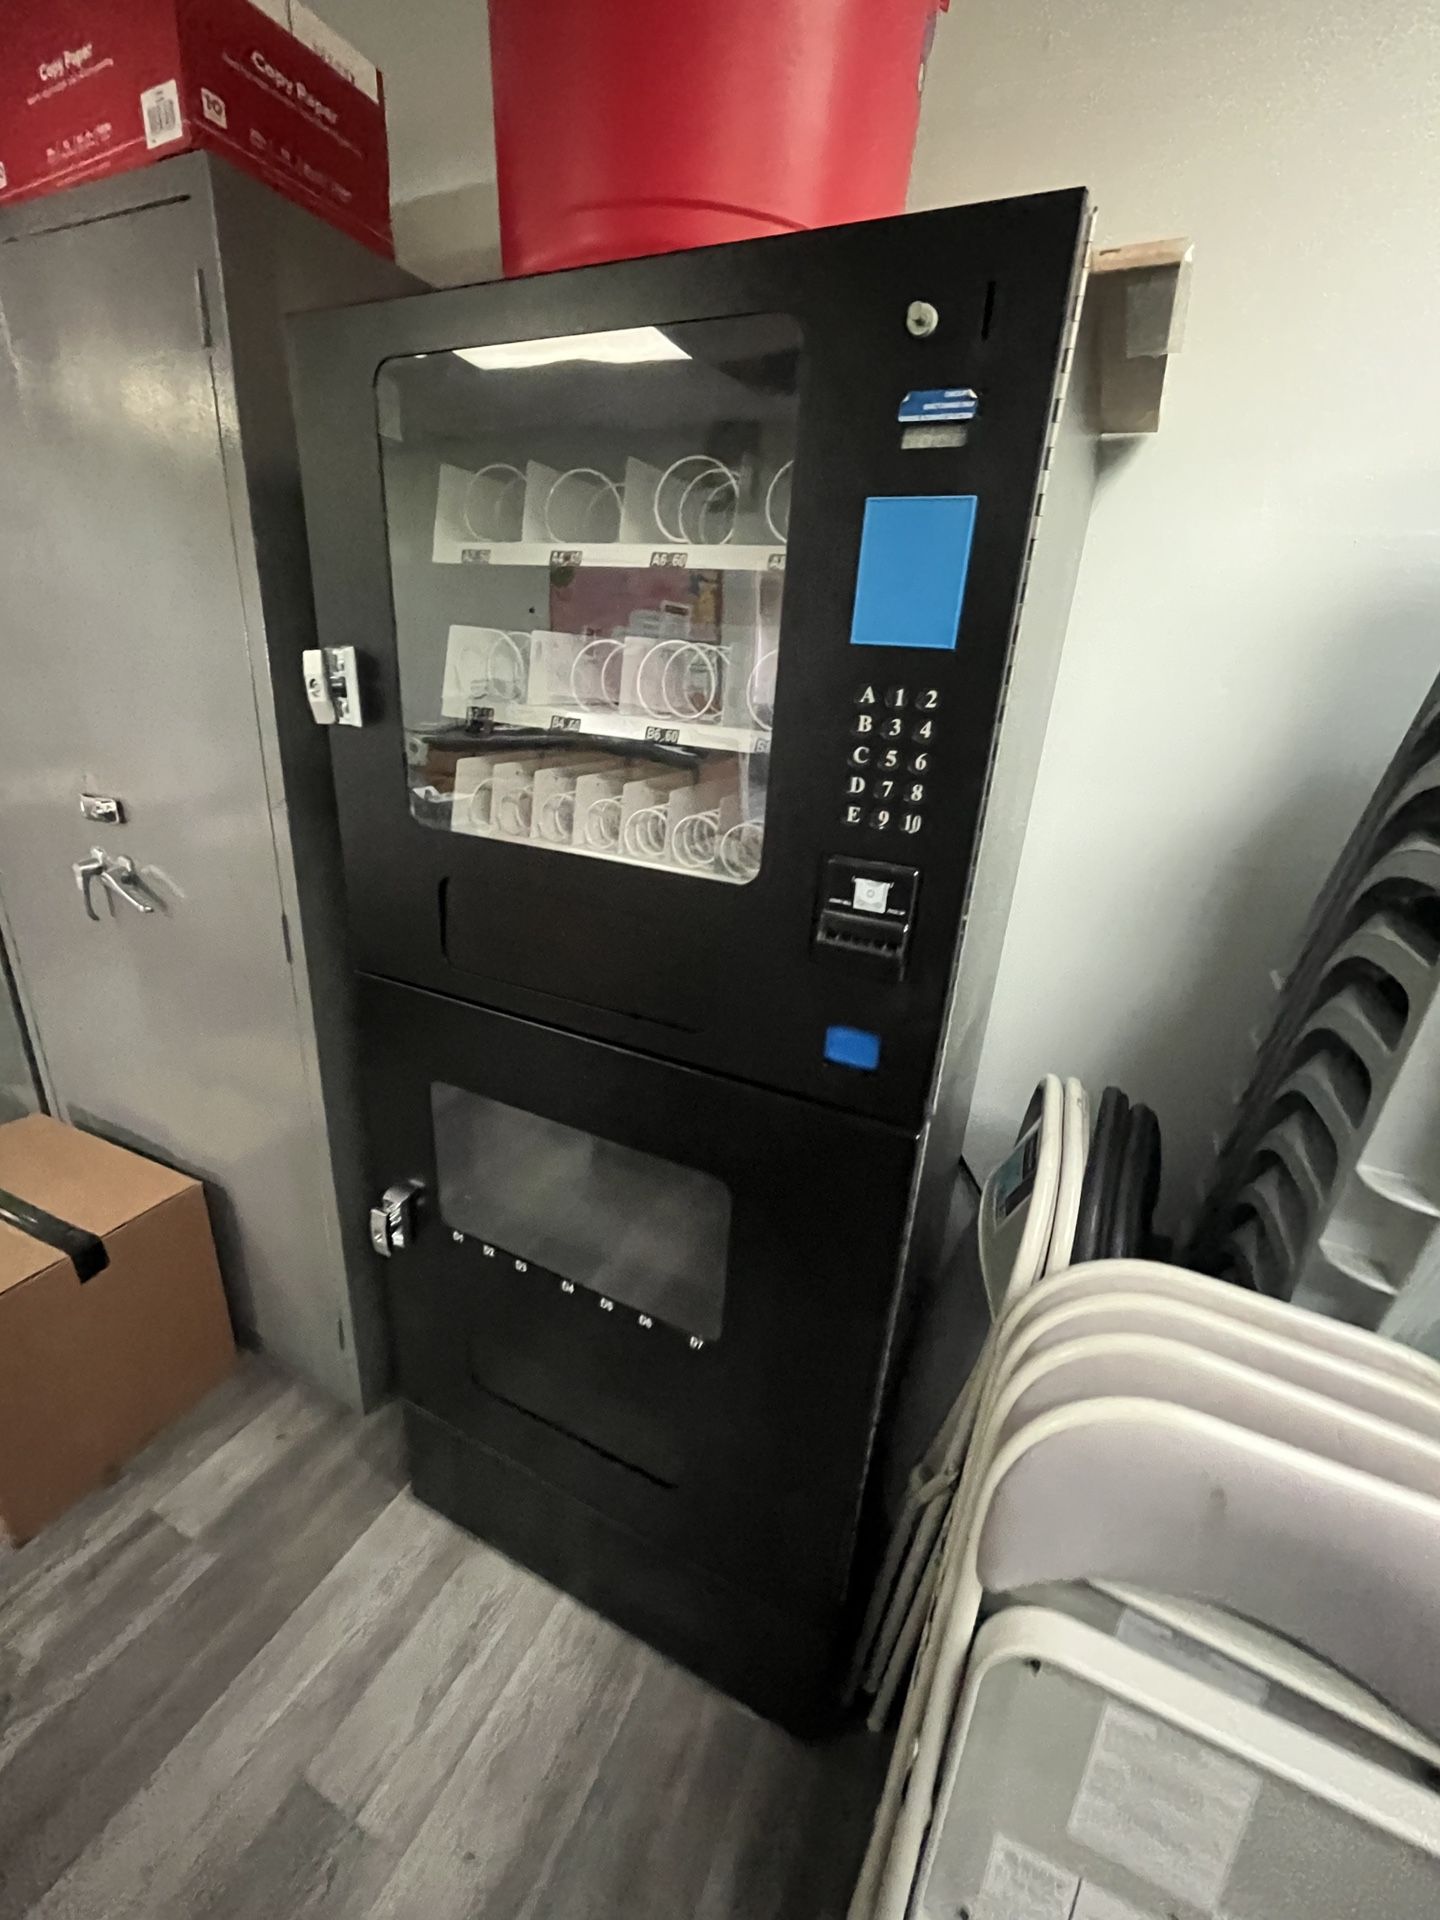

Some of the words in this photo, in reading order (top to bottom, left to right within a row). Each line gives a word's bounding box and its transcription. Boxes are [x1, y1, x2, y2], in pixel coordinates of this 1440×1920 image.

[38, 59, 64, 81] Copy
[63, 43, 92, 70] Paper
[251, 51, 293, 95] Copy
[296, 82, 338, 124] Paper
[860, 686, 875, 704] A
[895, 688, 905, 706] 1
[925, 690, 938, 708] 2
[857, 715, 873, 732] B
[889, 718, 901, 736] 3
[919, 720, 932, 738] 4
[853, 746, 870, 764] C
[885, 750, 898, 767] 5
[915, 752, 928, 770] 6
[850, 776, 866, 793] D
[882, 781, 894, 797] 7
[910, 784, 924, 801] 8
[847, 806, 861, 823] E
[878, 810, 890, 830] 9
[904, 814, 922, 834] 10
